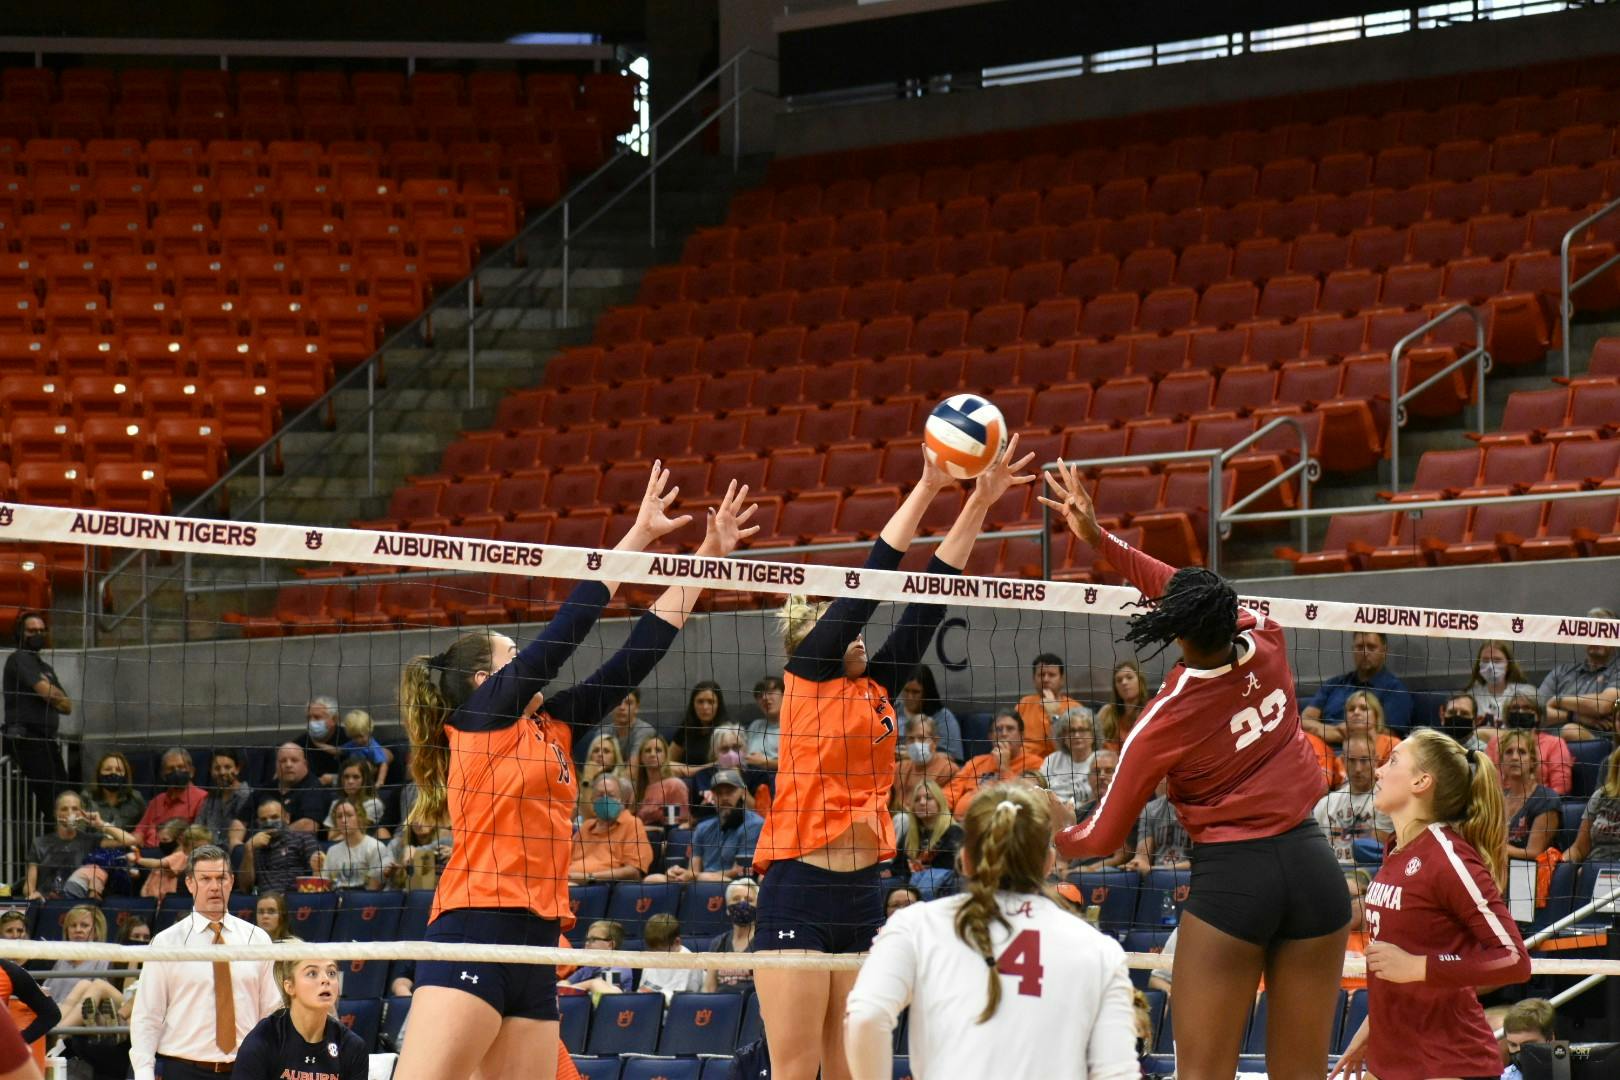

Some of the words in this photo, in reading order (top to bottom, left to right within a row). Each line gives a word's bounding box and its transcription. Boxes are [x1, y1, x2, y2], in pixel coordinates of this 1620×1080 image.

[70, 513, 170, 540] AUBURN
[174, 520, 257, 547] TIGERS
[373, 535, 464, 561] AUBURN
[468, 542, 544, 567] TIGERS
[648, 556, 732, 581] AUBURN
[736, 562, 805, 586] TIGERS
[902, 575, 979, 597] AUBURN
[983, 580, 1046, 602] TIGERS
[1354, 606, 1420, 627] AUBURN
[1423, 610, 1479, 631] TIGERS
[1557, 619, 1620, 639] AUBURN
[935, 617, 968, 672] C
[996, 929, 1044, 998] 4
